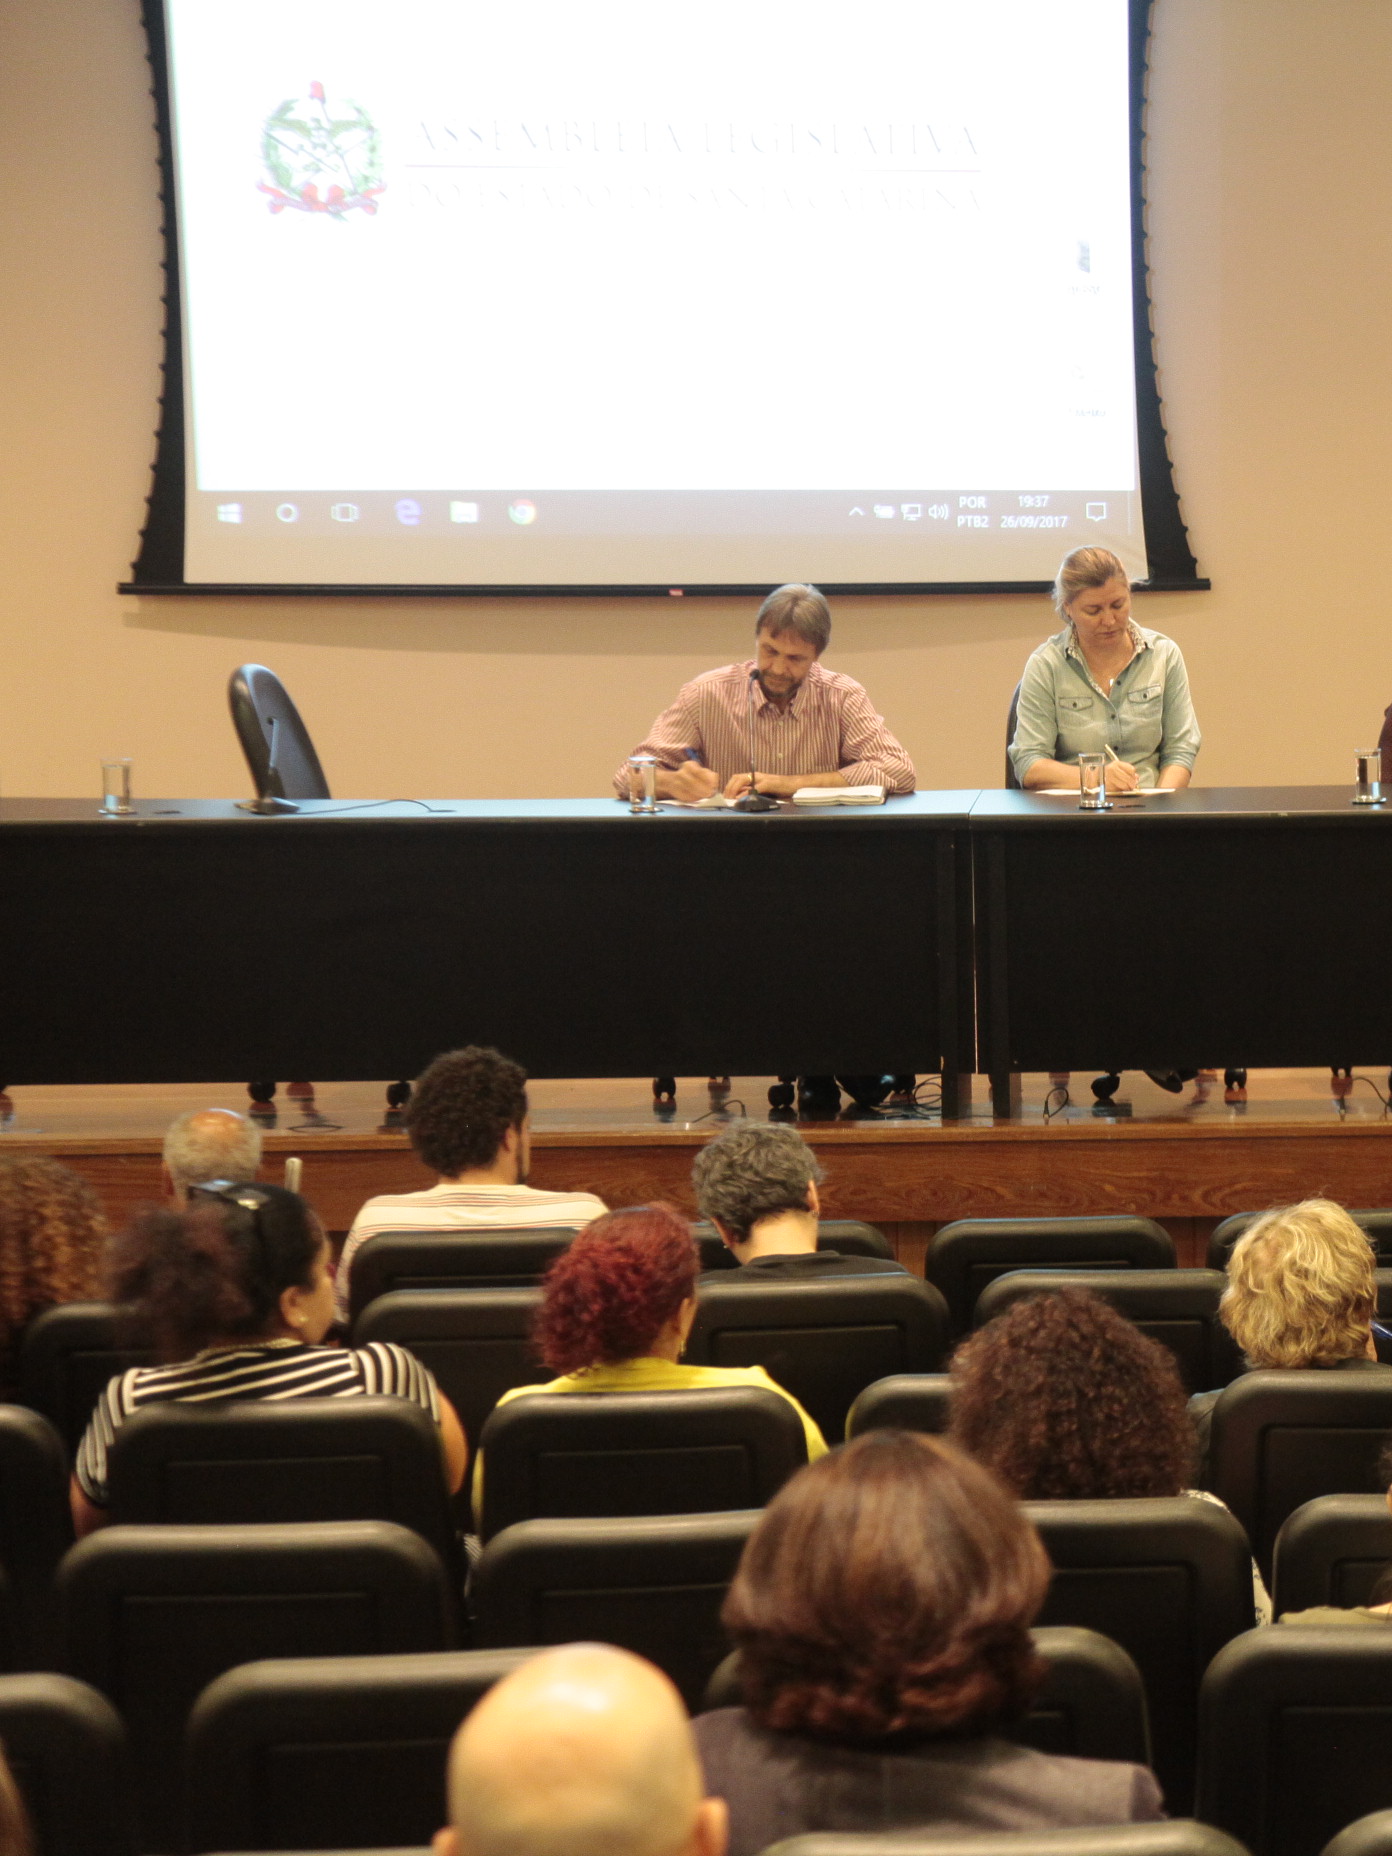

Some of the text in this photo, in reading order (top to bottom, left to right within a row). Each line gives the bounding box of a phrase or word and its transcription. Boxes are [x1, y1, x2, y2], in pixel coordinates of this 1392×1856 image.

[959, 496, 987, 509] POR
[1018, 495, 1050, 508] 19:37
[957, 515, 990, 528] PTB2
[1000, 515, 1069, 528] 26/09/2017
